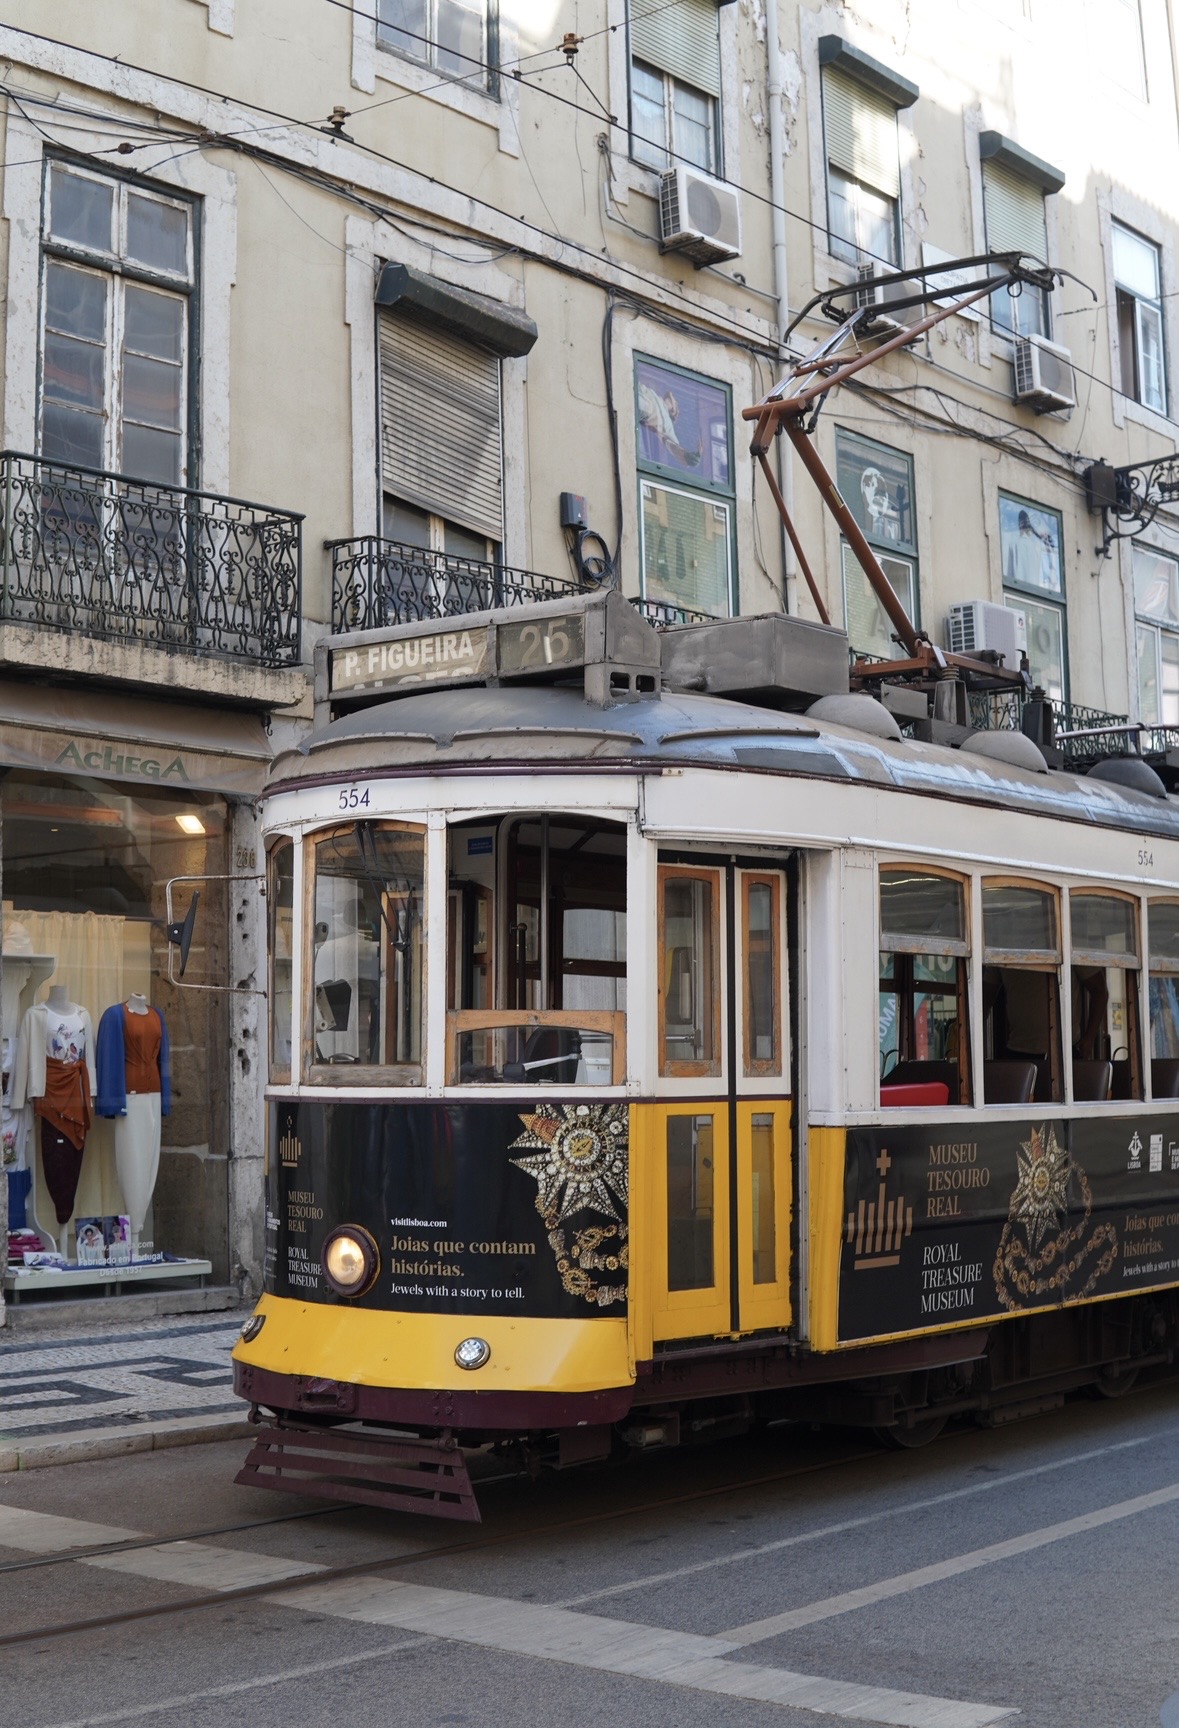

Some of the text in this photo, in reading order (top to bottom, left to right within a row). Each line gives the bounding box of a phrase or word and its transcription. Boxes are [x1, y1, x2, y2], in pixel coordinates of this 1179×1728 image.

[520, 618, 570, 667] 25
[345, 631, 474, 677] P. FIGUEIRA
[54, 740, 191, 782] ACHEGA
[338, 788, 370, 810] 554
[1137, 849, 1154, 867] 554
[929, 1143, 978, 1165] MUSEU
[927, 1167, 990, 1192] TESOURO
[288, 1190, 315, 1204] MUSEU
[927, 1195, 962, 1218] REAL
[288, 1204, 324, 1220] TESOURO
[288, 1220, 307, 1233] REAL
[391, 1217, 447, 1228] visitlisboa.com
[1124, 1213, 1147, 1232] Joias
[1148, 1215, 1165, 1232] que
[288, 1246, 309, 1260] ROYAL
[391, 1235, 536, 1256] Joias que contam
[923, 1243, 962, 1266] ROYAL
[1123, 1238, 1163, 1258] histórias.
[78, 1256, 117, 1267] Fabricado
[132, 1251, 164, 1263] Portugal
[288, 1260, 323, 1276] TREASURE
[391, 1258, 465, 1277] histórias.
[288, 1273, 318, 1289] MUSEUM
[921, 1263, 983, 1290] TREASURE
[391, 1283, 525, 1300] Jewels with a story to tell.
[920, 1287, 975, 1314] MUSEUM
